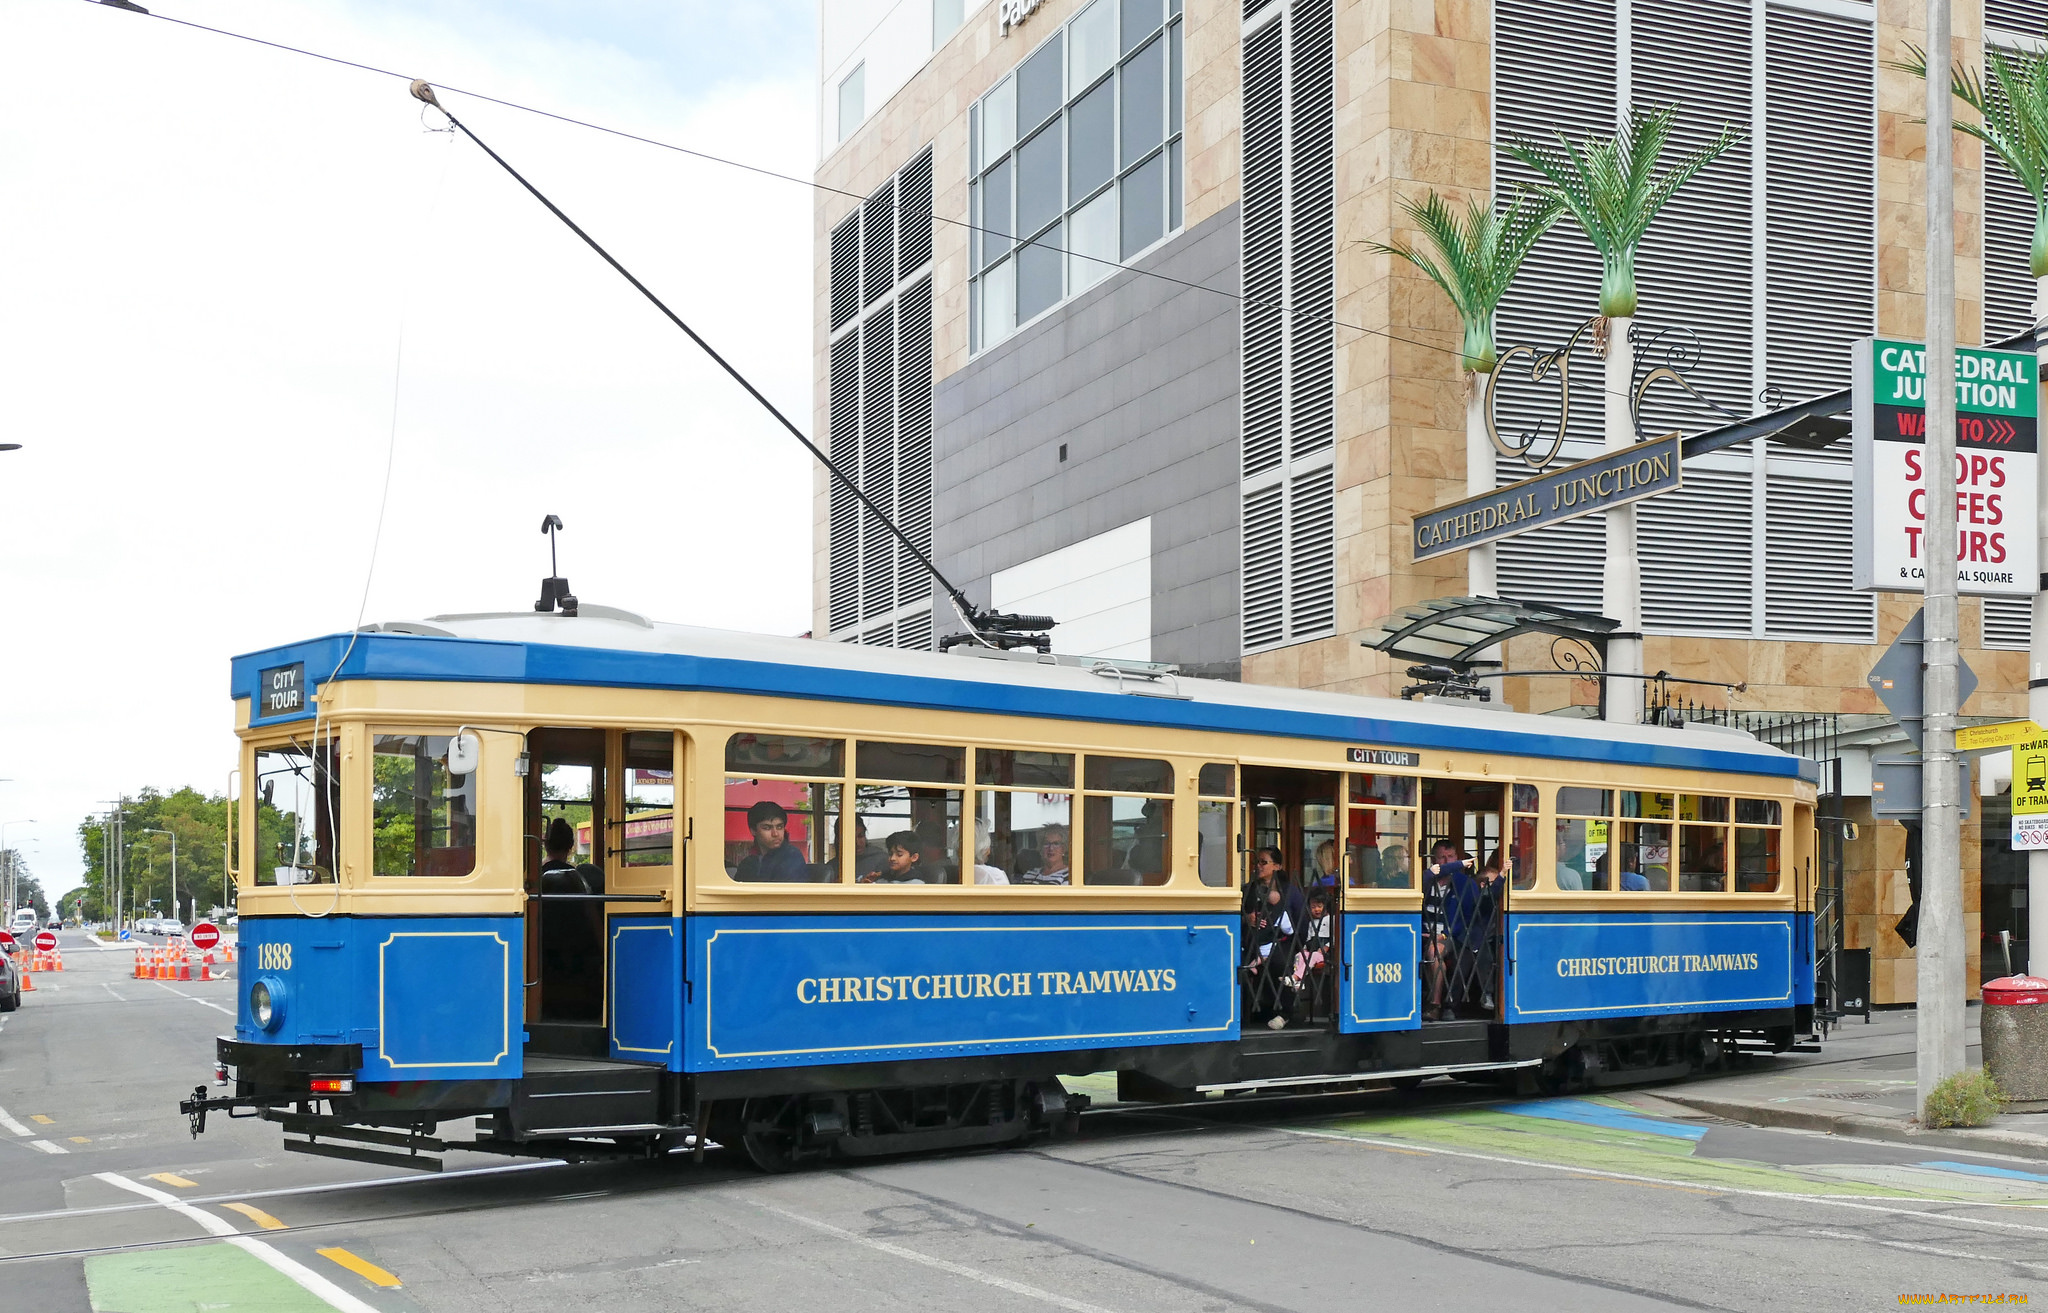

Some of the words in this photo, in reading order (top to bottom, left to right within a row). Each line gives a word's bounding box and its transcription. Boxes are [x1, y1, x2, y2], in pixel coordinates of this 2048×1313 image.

[1880, 347, 2029, 384] CATEDRAL
[1893, 376, 2016, 409] JUTION
[1897, 412, 1925, 436] WA
[1958, 418, 1984, 442] TO
[1904, 449, 2006, 488] SOPS
[1417, 493, 1542, 549] CATHEDRAL
[1552, 452, 1672, 510] JUNCTION
[1908, 488, 2003, 526] CFES
[1904, 526, 2007, 563] TURS
[1900, 567, 1907, 577] &
[1973, 571, 2013, 583] SQUARE
[273, 670, 296, 690] CITY
[270, 690, 298, 710] TOUR
[1353, 749, 1378, 763] CITY
[1380, 750, 1409, 765] TOUR
[2020, 740, 2048, 750] BEWAR
[2017, 797, 2026, 806] OF
[258, 943, 292, 970] 1888
[1556, 955, 1680, 978] CHRISTCHURCH
[1682, 953, 1758, 972] TRAMWAYS
[796, 972, 1032, 1004] CHRISTCHURCH
[1038, 969, 1177, 995] TRAMWAYS
[1366, 962, 1402, 984] 1888
